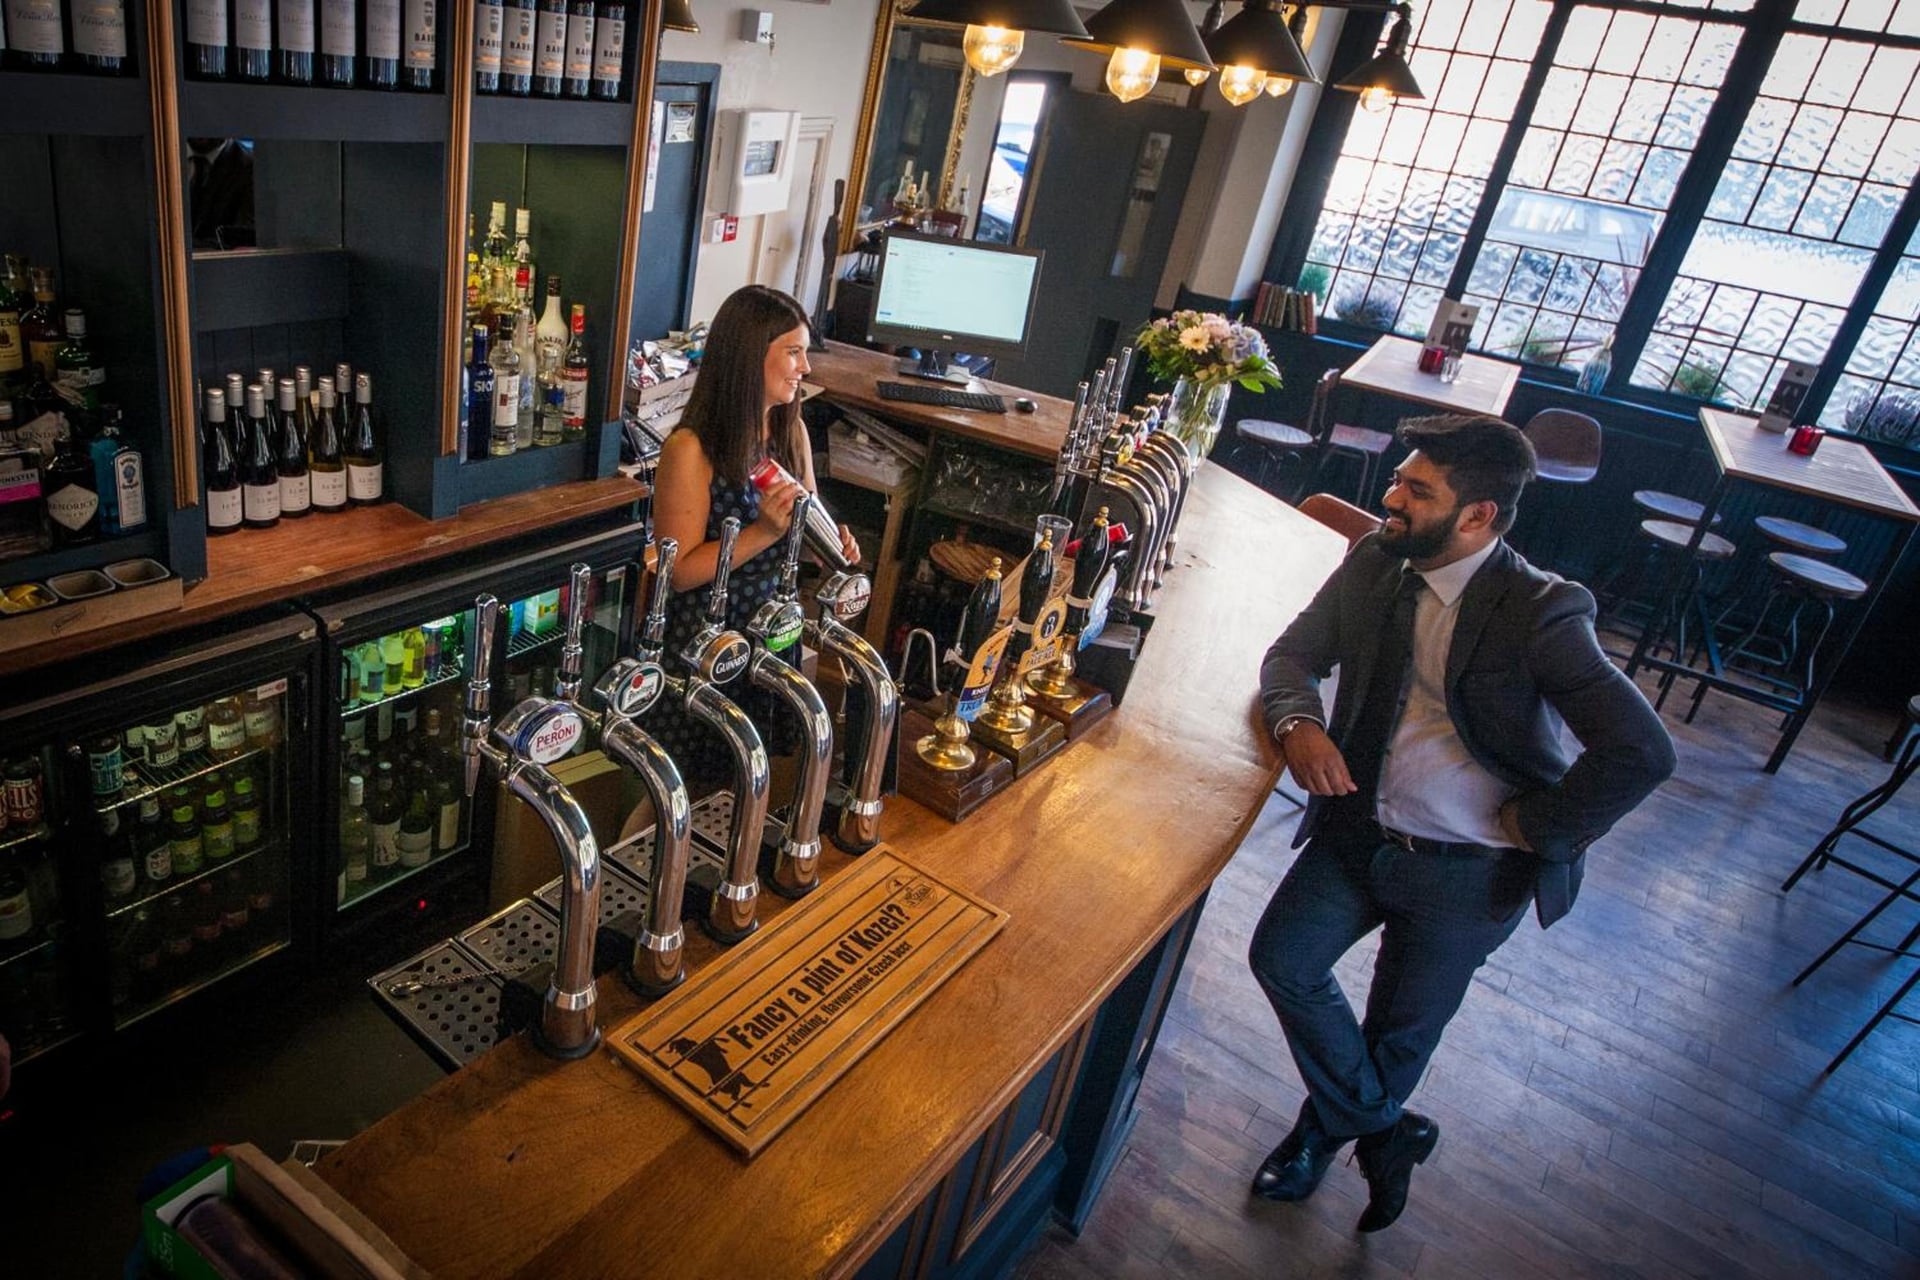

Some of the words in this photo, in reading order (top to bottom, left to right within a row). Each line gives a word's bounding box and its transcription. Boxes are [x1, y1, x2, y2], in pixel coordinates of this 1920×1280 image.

[536, 724, 577, 748] PERONI
[847, 903, 910, 951] Kozel?
[835, 940, 864, 965] of
[787, 987, 812, 1004] a
[800, 957, 846, 996] pint
[760, 1014, 829, 1066] Easy-drinking,
[820, 973, 873, 1016] flavoursome
[867, 954, 897, 977] Czech
[888, 940, 913, 959] beer
[726, 997, 800, 1050] Fancy
